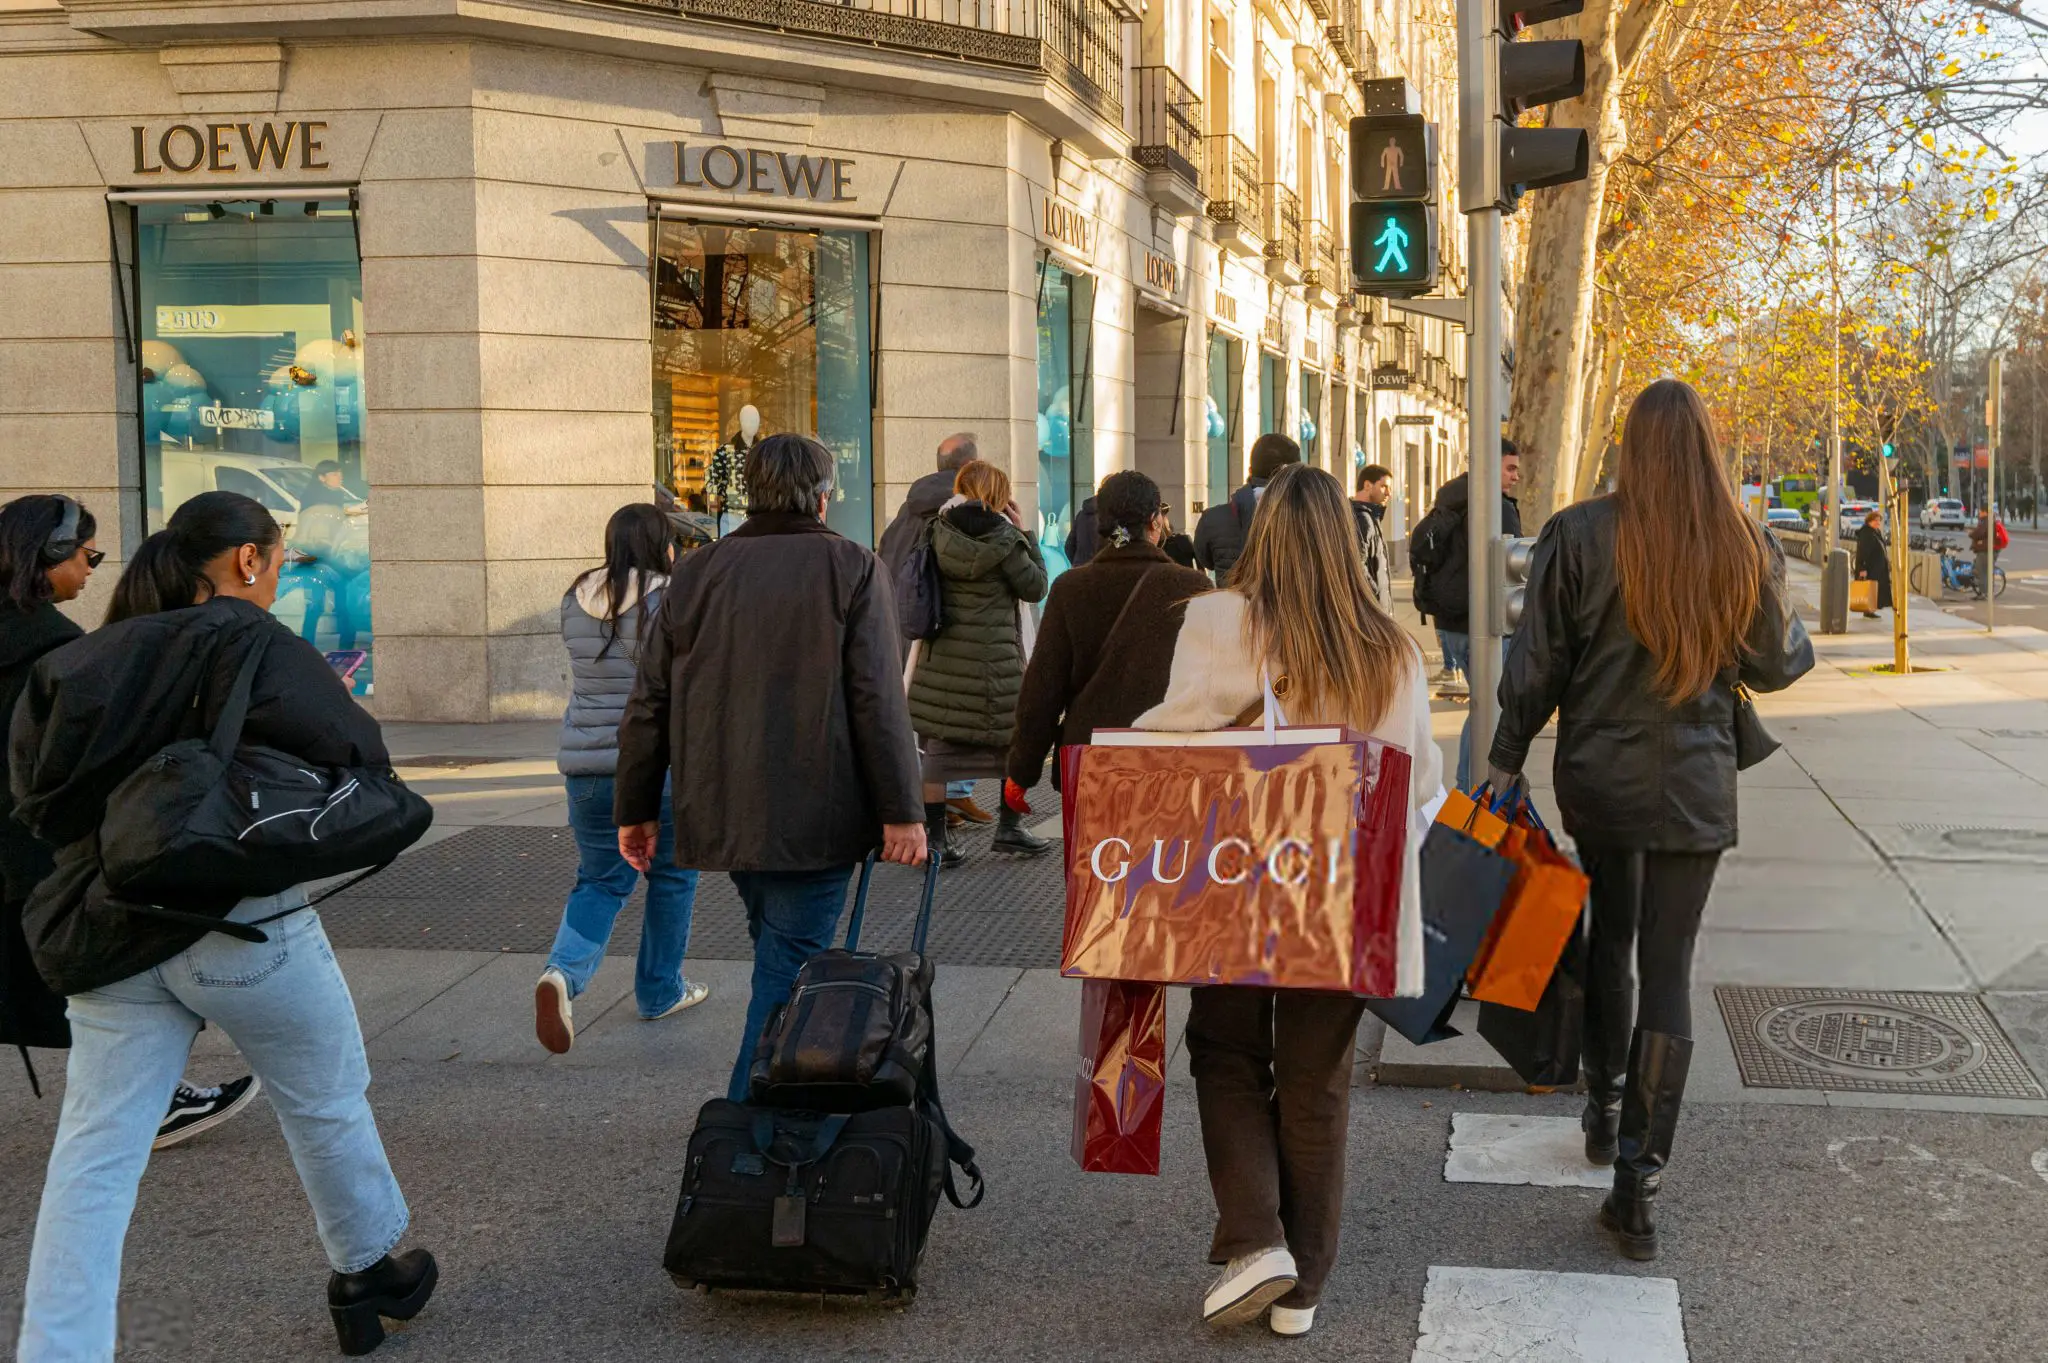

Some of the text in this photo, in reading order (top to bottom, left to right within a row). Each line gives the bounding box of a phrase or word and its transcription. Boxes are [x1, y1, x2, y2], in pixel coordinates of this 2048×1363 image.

[131, 121, 329, 175] LOEWE
[673, 140, 858, 202] LOEWE
[1373, 375, 1408, 385] LOEWE
[1090, 837, 1340, 884] GUCCI
